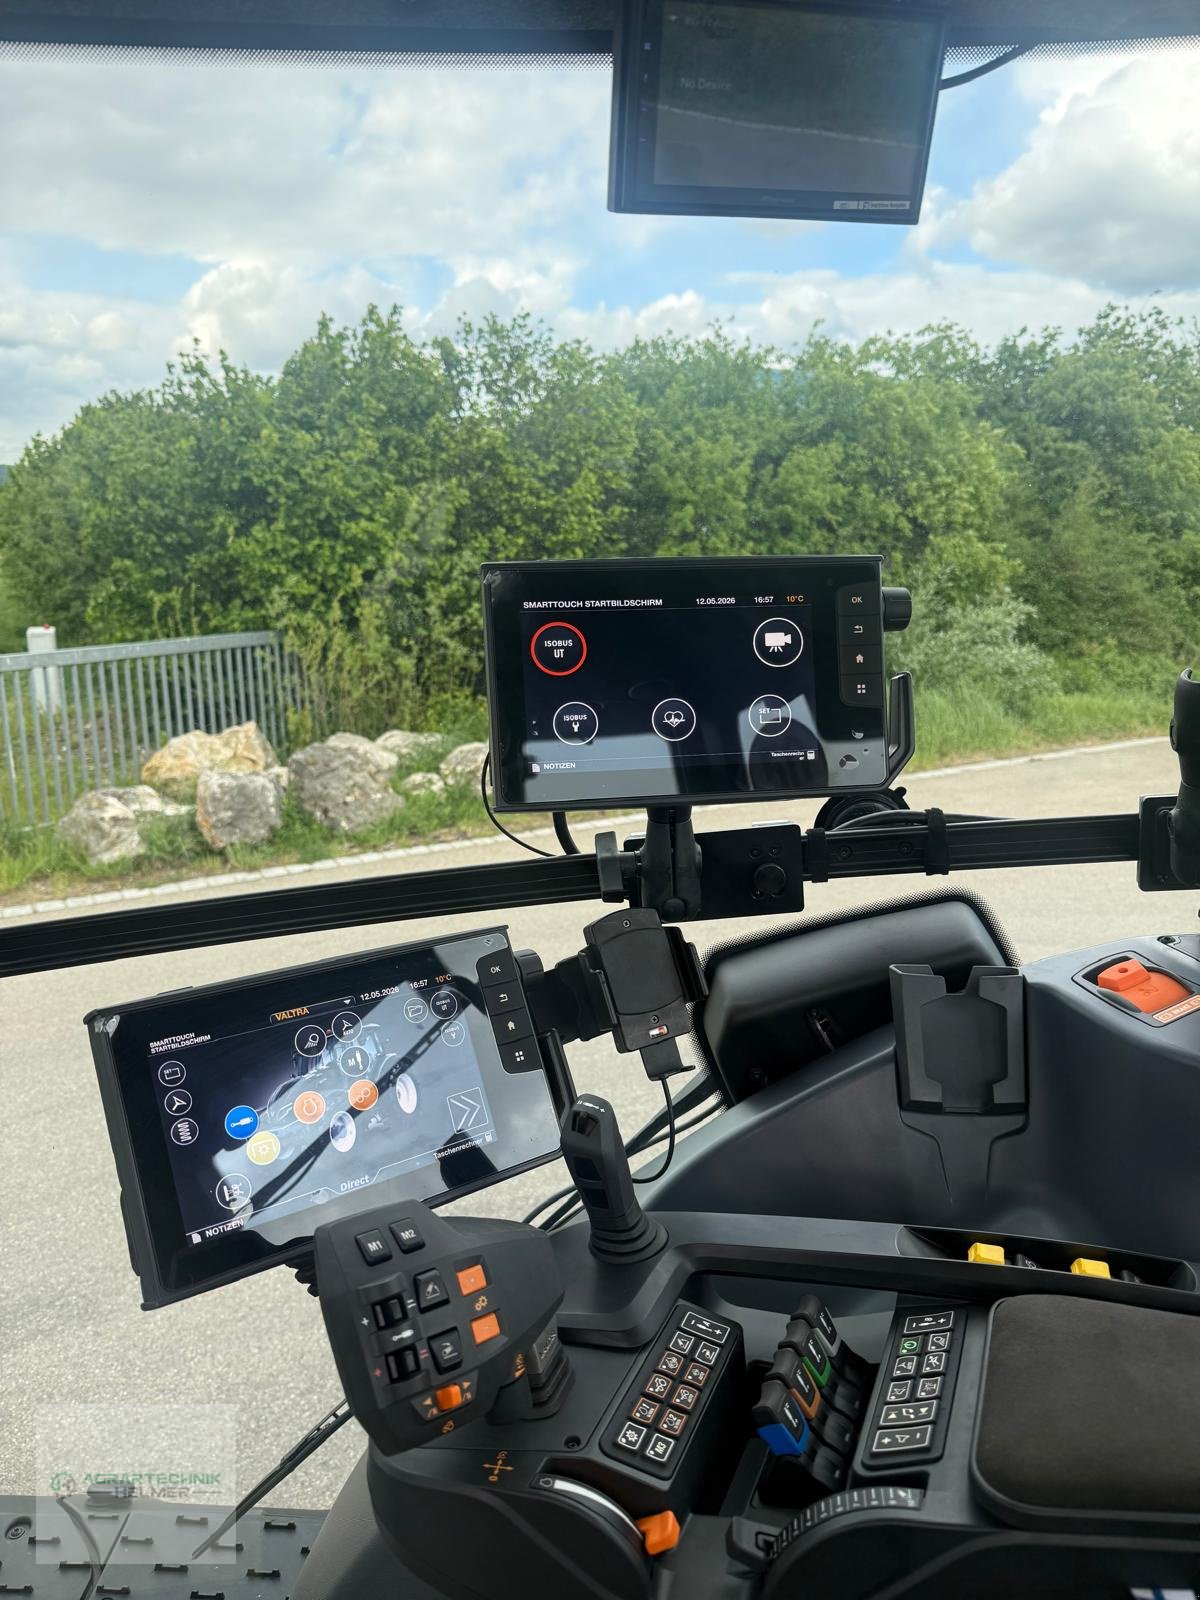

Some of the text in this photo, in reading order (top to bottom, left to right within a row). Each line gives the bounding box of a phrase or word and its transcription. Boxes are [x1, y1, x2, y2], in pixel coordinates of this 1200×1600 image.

[523, 599, 663, 609] SMARTTOUCH STARTBILDSCHIRM
[696, 597, 736, 605] 12.05.2026
[786, 595, 804, 603] 10°C
[851, 596, 863, 604] OK
[544, 639, 573, 647] ISOBUS
[553, 649, 564, 658] UT
[543, 762, 576, 770] NOTIZEN
[490, 966, 501, 974] OK
[434, 973, 452, 983] 10°C
[409, 979, 428, 989] 16:57
[360, 986, 400, 1001] 12.05.2026
[275, 1007, 309, 1021] VALTRA
[149, 1032, 195, 1048] SMARTTOUCH
[150, 1034, 211, 1054] STARTBILDSCHIRM
[433, 1138, 483, 1159] Taschenrechner
[340, 1175, 370, 1192] Direct
[205, 1218, 244, 1238] NOTIZEN
[400, 1229, 416, 1241] M2
[367, 1240, 383, 1252] M1
[654, 1441, 667, 1454] M3
